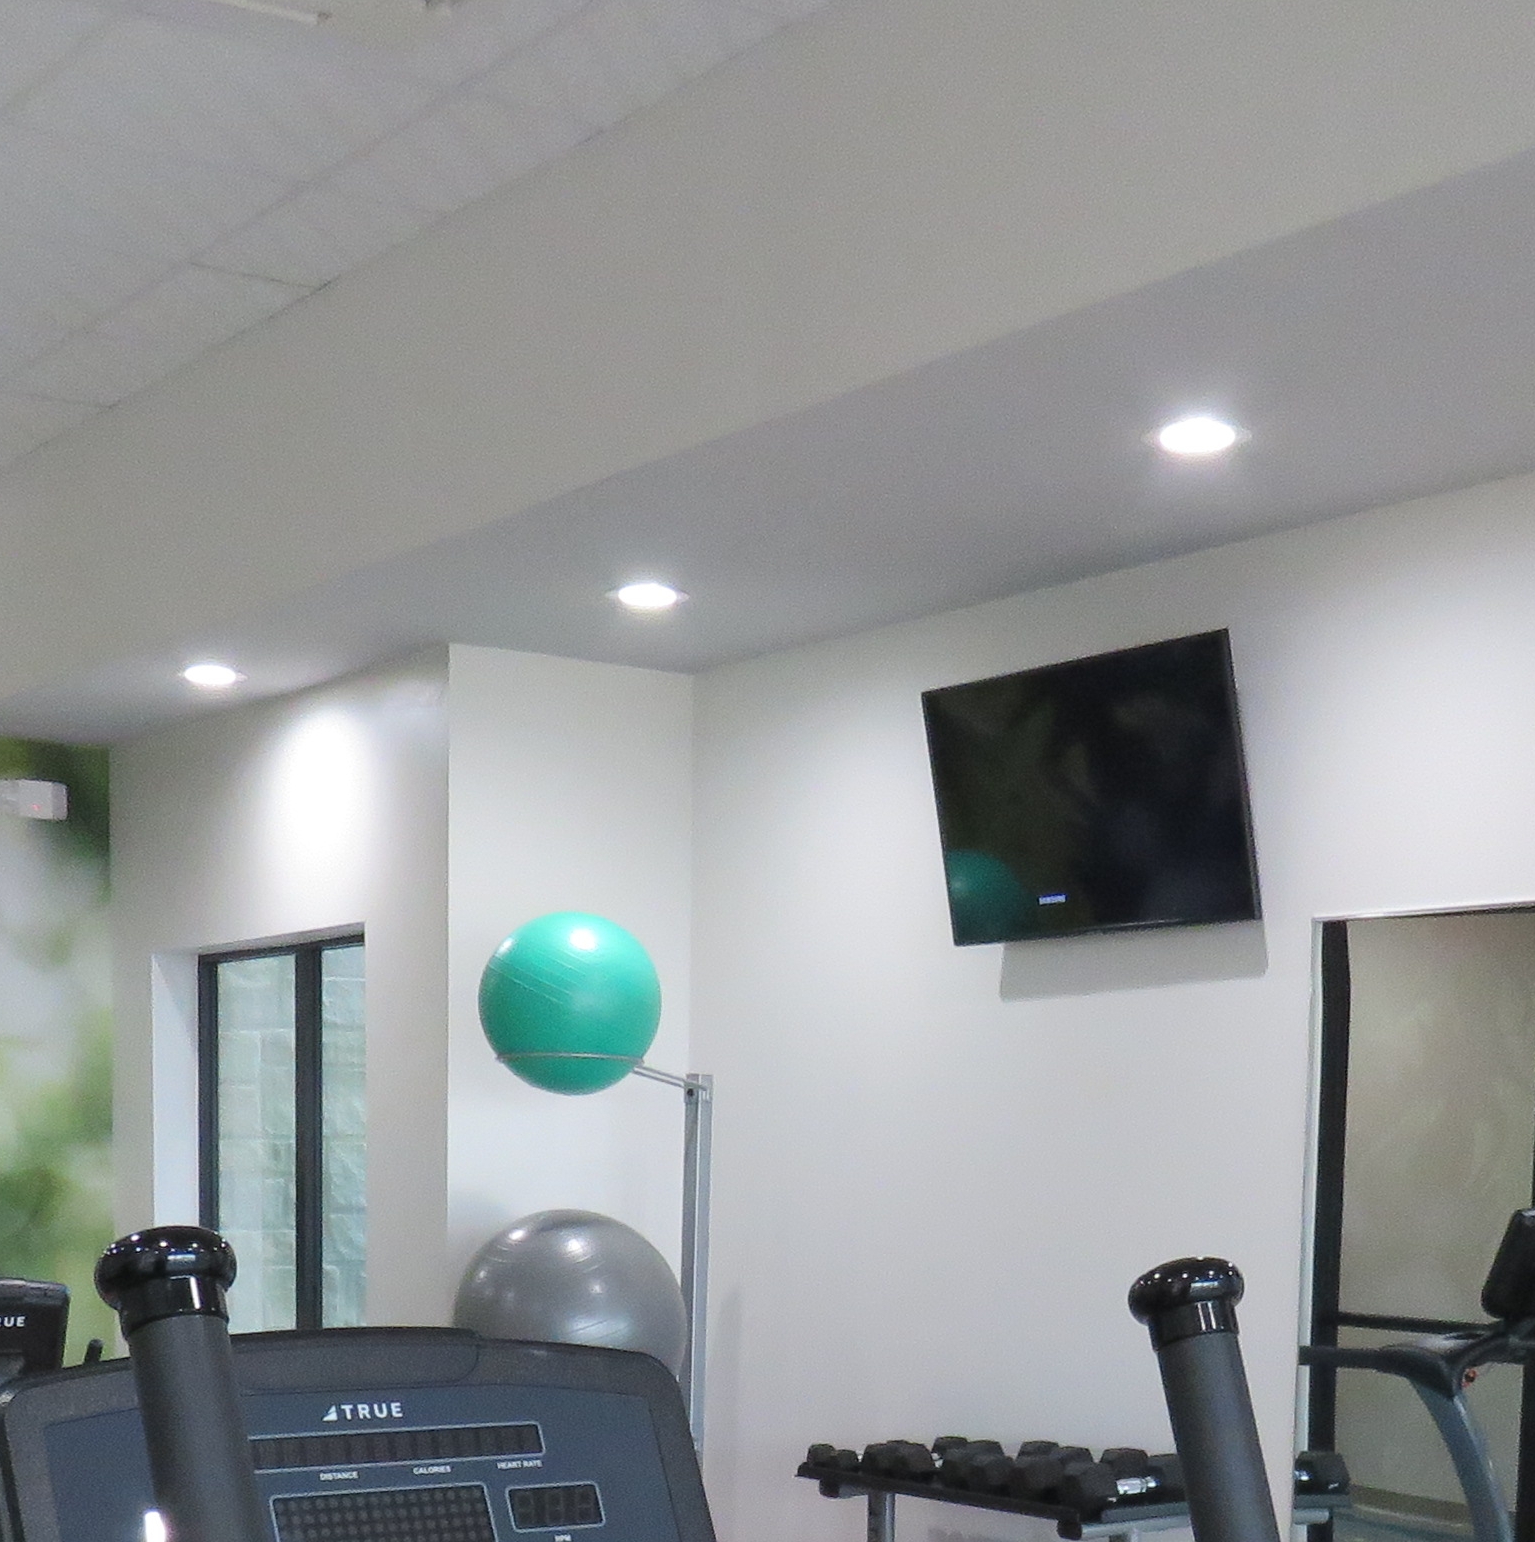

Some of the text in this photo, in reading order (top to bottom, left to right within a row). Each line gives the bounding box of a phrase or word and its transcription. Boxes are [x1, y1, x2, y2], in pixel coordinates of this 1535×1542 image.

[341, 1402, 403, 1420] TRUE
[497, 1459, 543, 1470] HEART RATE
[412, 1465, 452, 1475] CALORIES
[319, 1471, 359, 1481] DISTANCE
